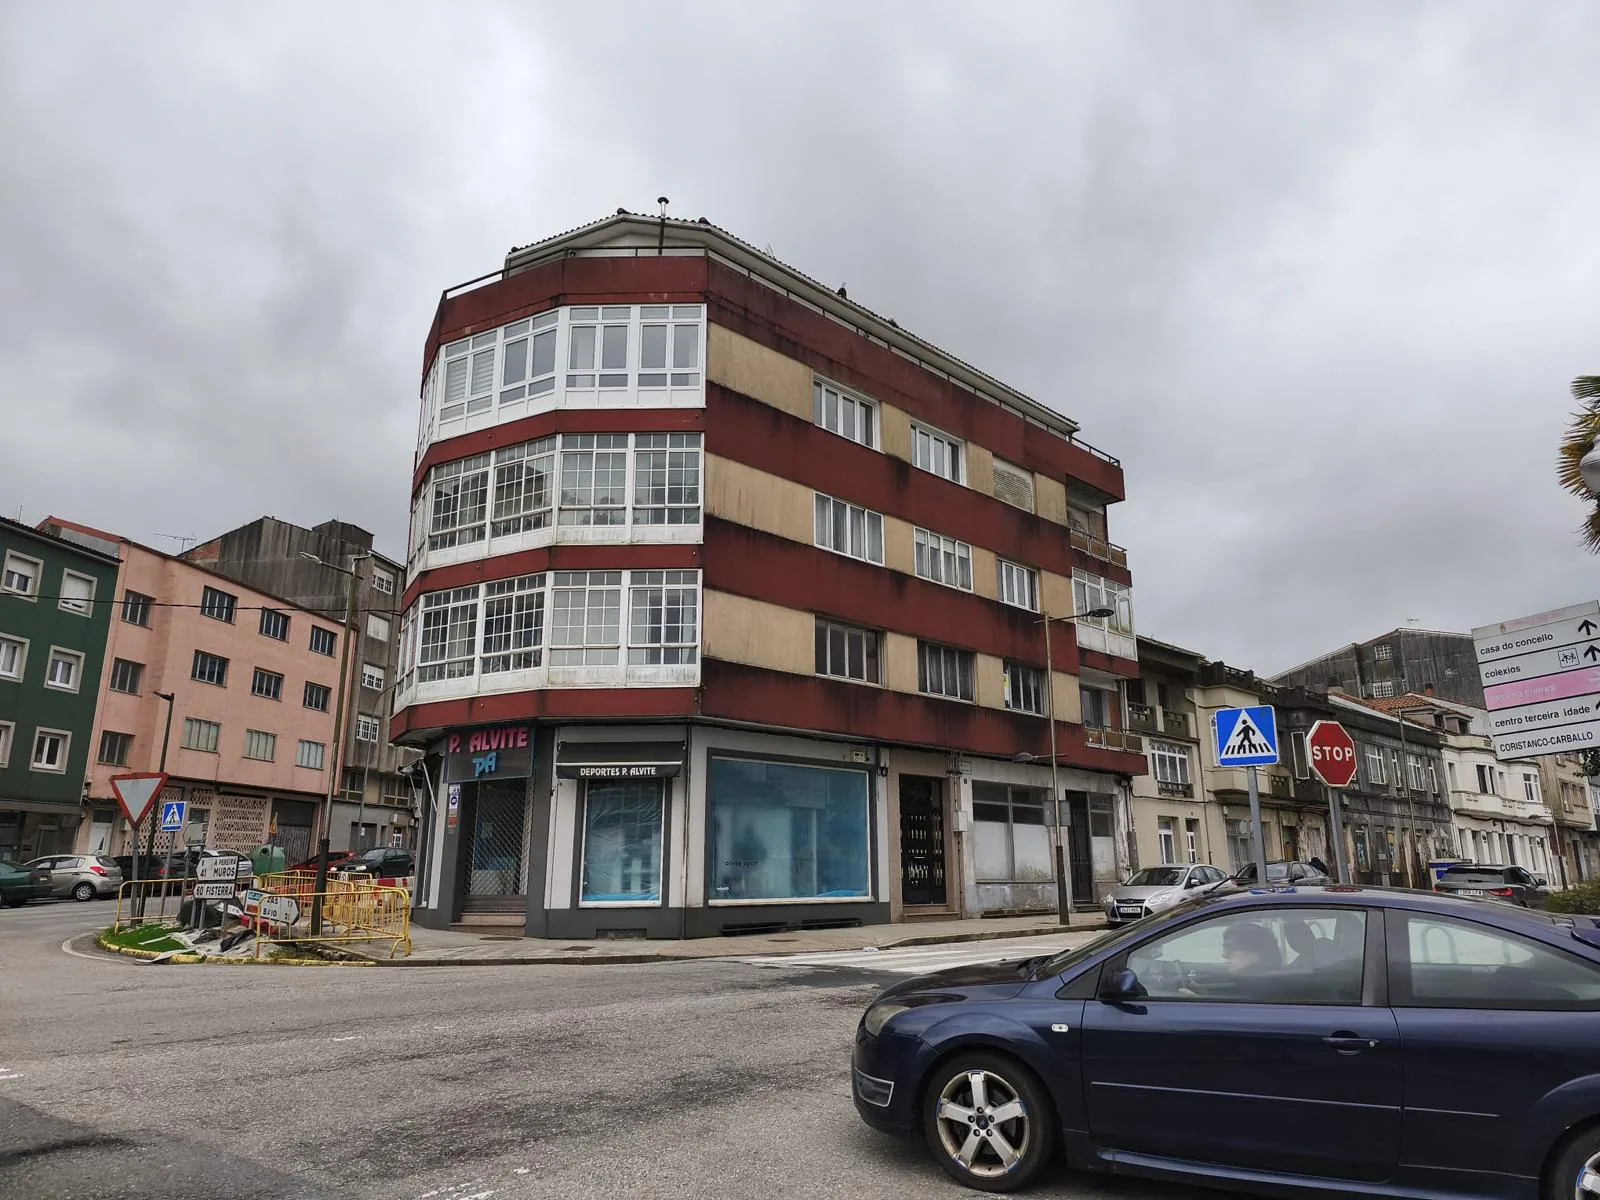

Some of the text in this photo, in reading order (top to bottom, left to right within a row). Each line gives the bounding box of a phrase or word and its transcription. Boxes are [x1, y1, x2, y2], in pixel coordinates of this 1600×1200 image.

[1480, 634, 1554, 655] casa do concello
[1485, 666, 1521, 678] colexios
[1495, 706, 1591, 728] centro terceira idade
[469, 727, 528, 753] ALVITE
[1500, 731, 1594, 752] CORISTANCO-CARBALLO
[1312, 745, 1353, 762] STOP
[580, 766, 656, 777] DEPORTES P. ALVITE
[213, 867, 236, 877] MUROS
[196, 886, 234, 896] 60 FISTERRA
